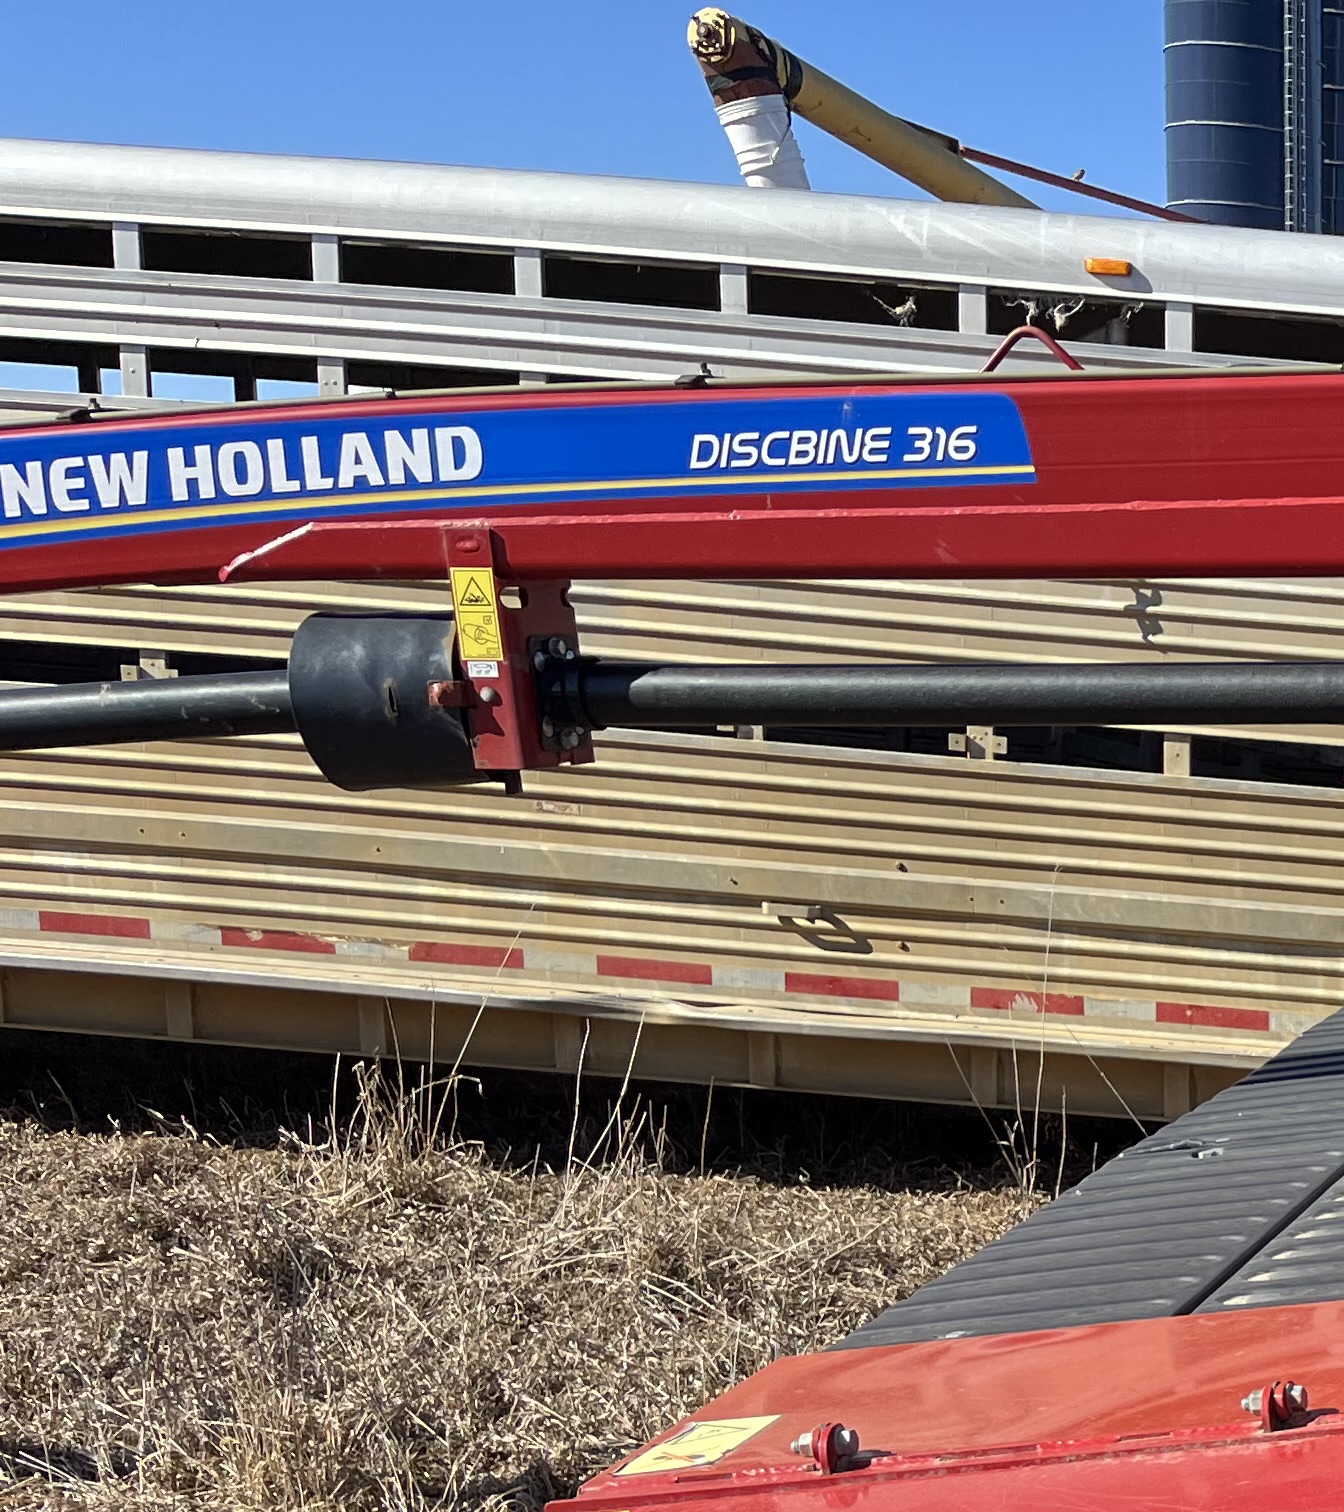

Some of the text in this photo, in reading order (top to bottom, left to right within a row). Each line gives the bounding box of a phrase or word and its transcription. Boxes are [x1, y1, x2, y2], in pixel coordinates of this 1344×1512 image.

[2, 425, 484, 519] NEW HOLLAND
[689, 425, 978, 470] DISCBINE 316
